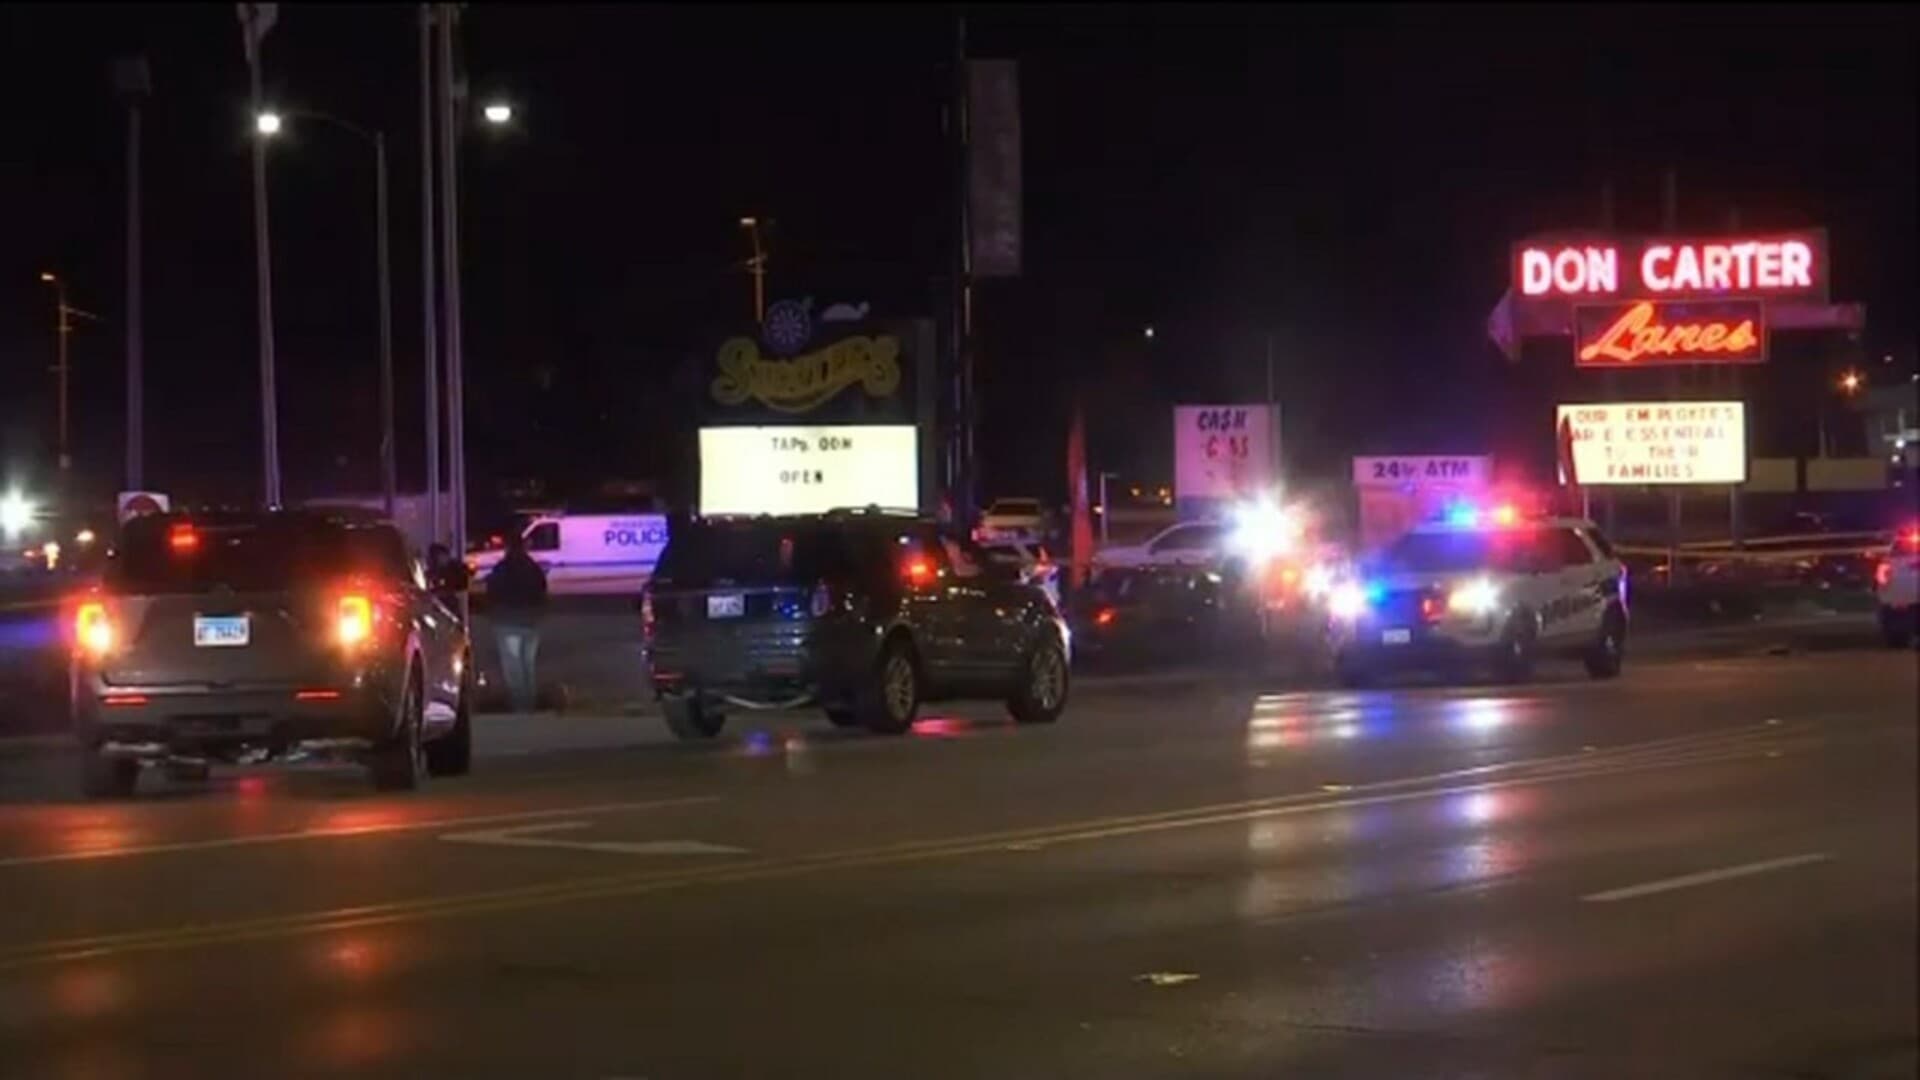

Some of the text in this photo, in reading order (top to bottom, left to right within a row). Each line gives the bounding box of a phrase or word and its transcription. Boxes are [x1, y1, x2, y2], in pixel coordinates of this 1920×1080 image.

[1522, 241, 1812, 294] DON CARTER
[1580, 301, 1757, 361] Lanes
[1425, 460, 1470, 478] ATM
